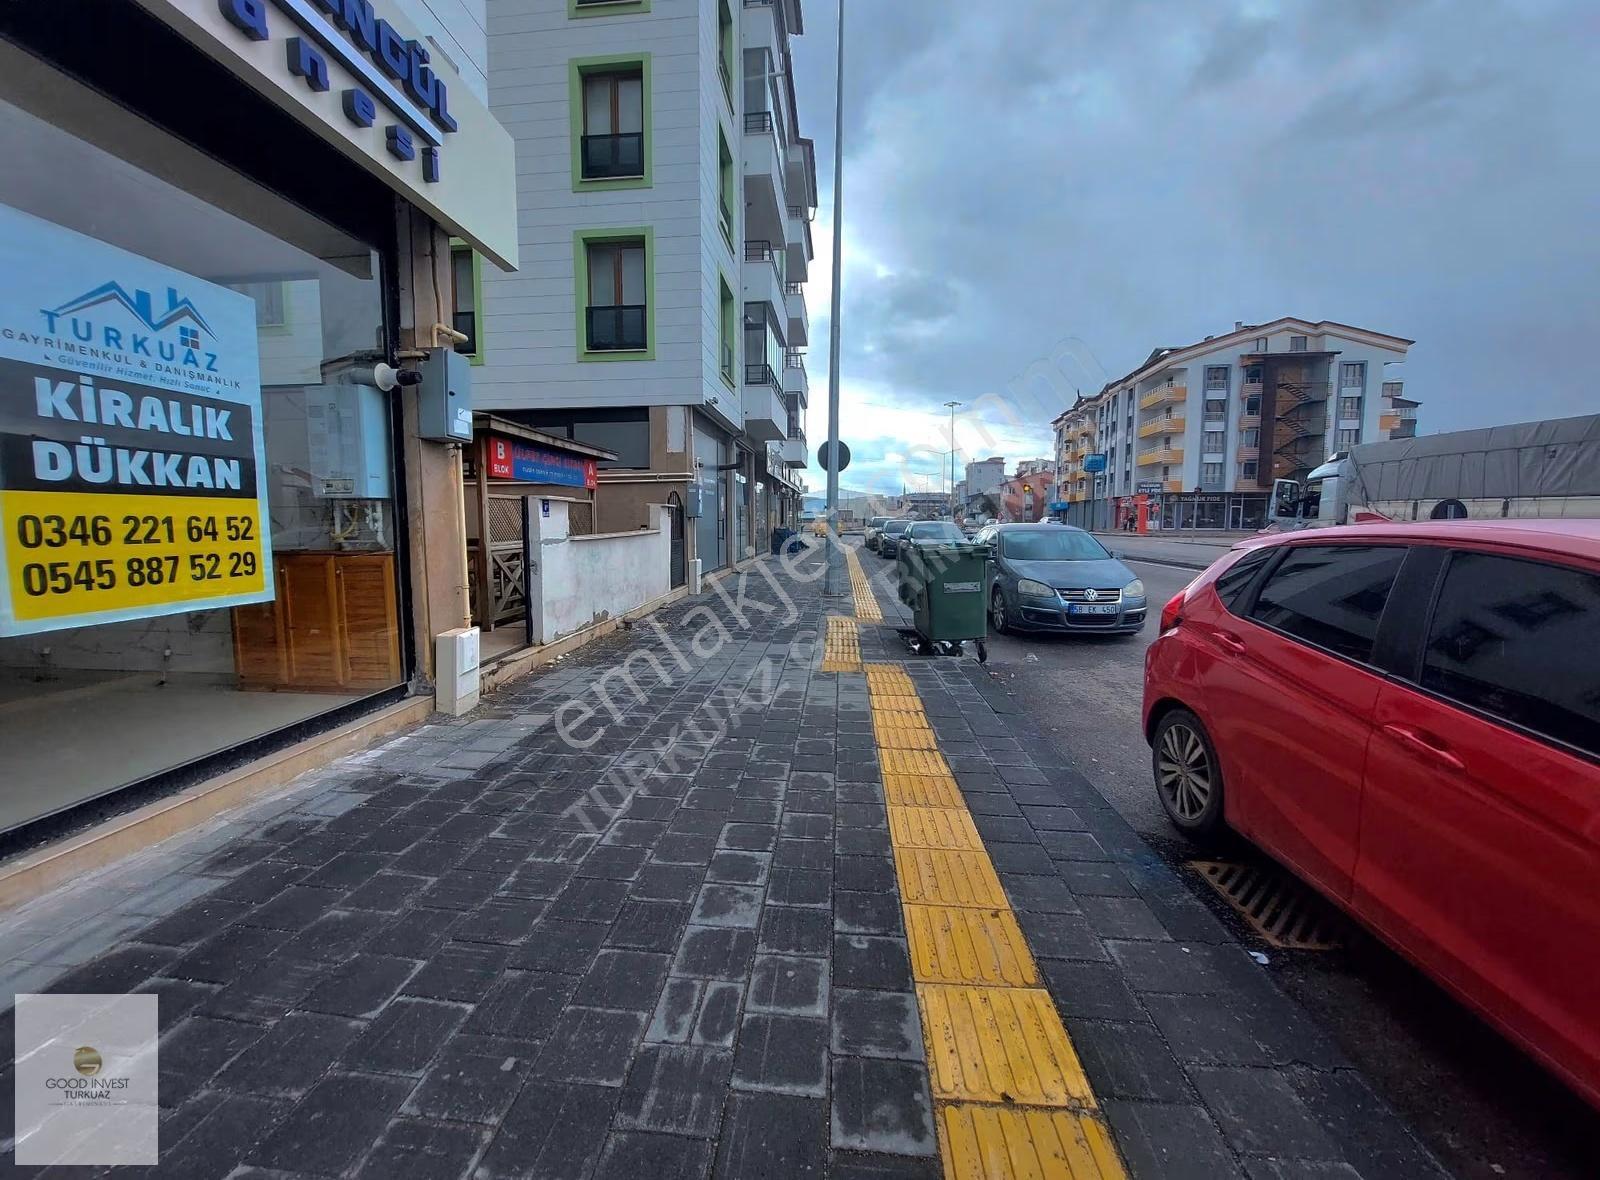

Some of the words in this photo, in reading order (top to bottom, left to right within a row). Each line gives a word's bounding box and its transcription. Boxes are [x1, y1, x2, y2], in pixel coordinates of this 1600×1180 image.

[313, 0, 458, 133] NGÜL
[40, 309, 219, 373] TURKUAZ
[139, 361, 148, 369] &
[155, 362, 241, 390] DANIŞMANLIK
[34, 375, 233, 441] KİRALIK
[32, 436, 241, 490] DÜKKAN
[497, 442, 505, 459] B
[588, 463, 594, 476] A
[17, 515, 113, 549] 0346
[122, 516, 175, 545] 221
[187, 516, 218, 542] 64
[226, 516, 254, 541] 52
[22, 560, 117, 597] 0545
[126, 556, 180, 587] 887
[190, 553, 221, 581] 52
[229, 551, 257, 578] 29
